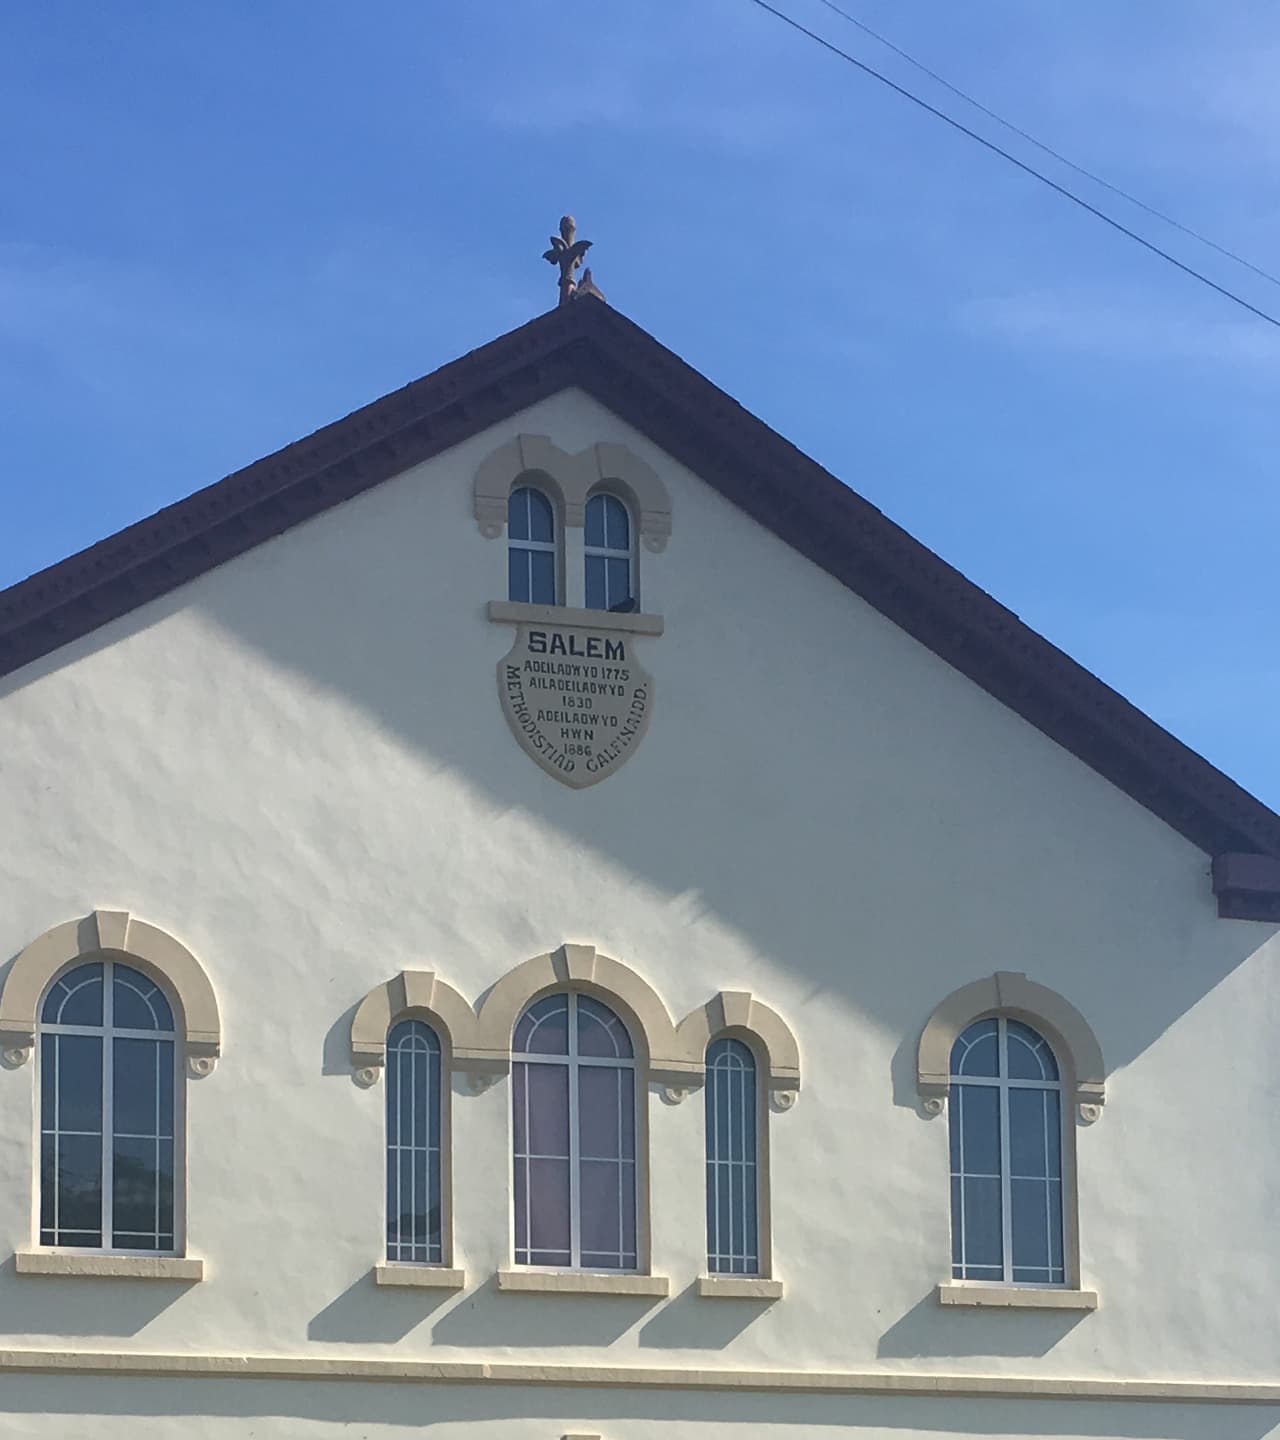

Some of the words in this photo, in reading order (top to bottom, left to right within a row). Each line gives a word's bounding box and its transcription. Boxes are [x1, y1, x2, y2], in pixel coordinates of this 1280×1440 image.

[528, 631, 625, 661] SALEM
[602, 667, 630, 681] 1775
[562, 696, 592, 709] 1830
[537, 710, 618, 727] ADEILADWYD
[561, 728, 594, 741] HWN
